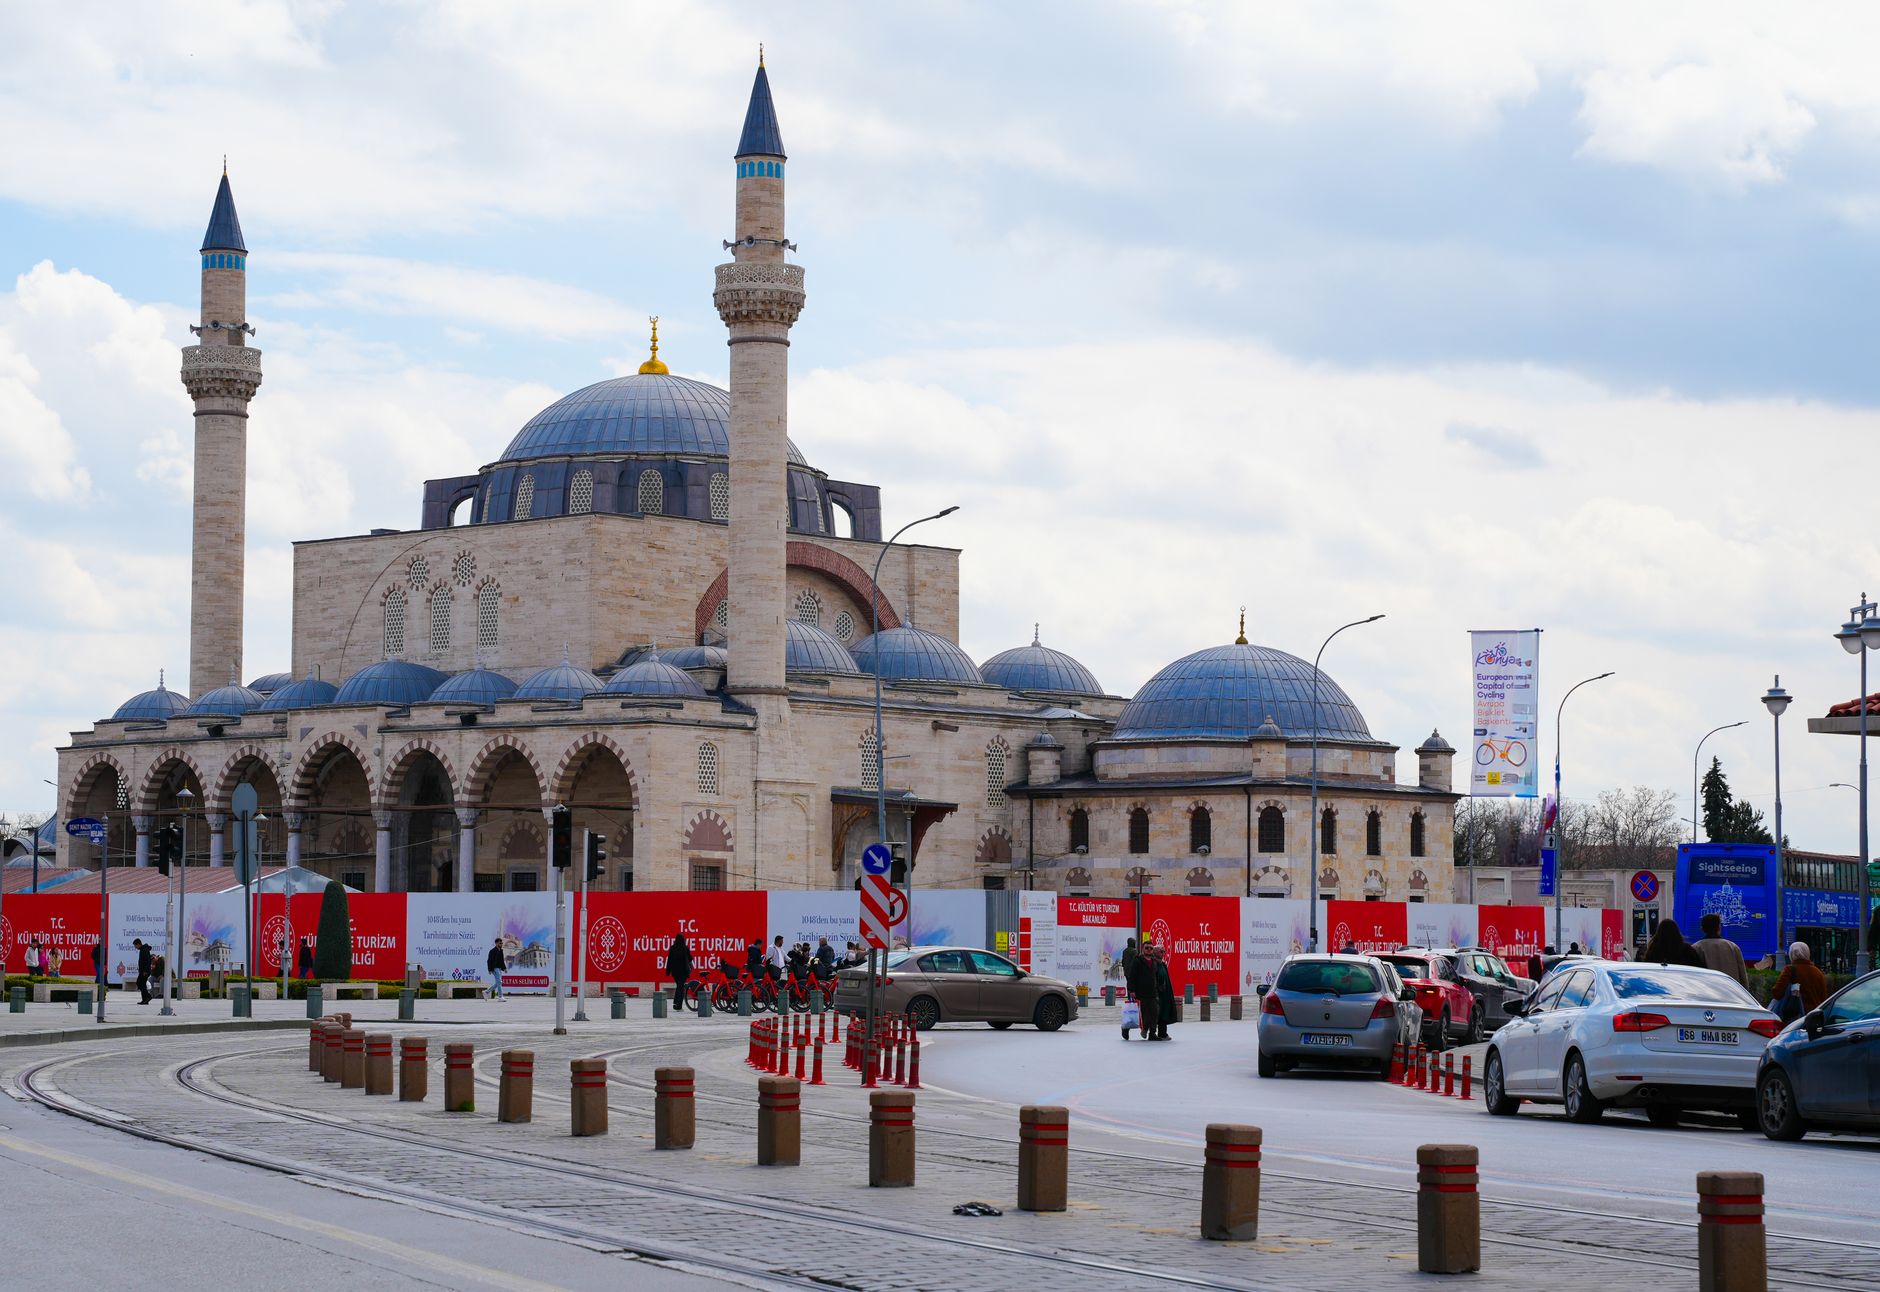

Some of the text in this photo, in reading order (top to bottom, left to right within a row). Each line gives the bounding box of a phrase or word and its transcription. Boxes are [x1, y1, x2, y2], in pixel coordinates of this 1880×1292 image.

[1477, 682, 1504, 690] Capital
[1477, 691, 1505, 699] Cycling
[1698, 862, 1758, 875] Sightseeing
[1096, 903, 1102, 912] VE
[50, 917, 66, 929] T.C.
[451, 915, 458, 923] bu
[458, 917, 472, 925] yana
[678, 919, 698, 933] T.C.
[830, 915, 837, 924] bu
[838, 917, 855, 926] yana
[423, 930, 458, 940] Tarihimizin
[1199, 922, 1211, 936] T.C.
[52, 933, 64, 945] VE
[66, 931, 100, 945] TURİZM
[356, 933, 396, 949] TURİZM
[699, 935, 745, 951] TURİZM
[1174, 939, 1200, 953] KÜLTÜR
[1201, 941, 1209, 953] VE
[1210, 938, 1234, 953] TURİZM
[1187, 956, 1222, 971] BAKANLIĞI
[1684, 1030, 1695, 1040] 68
[1721, 1032, 1738, 1043] 882
